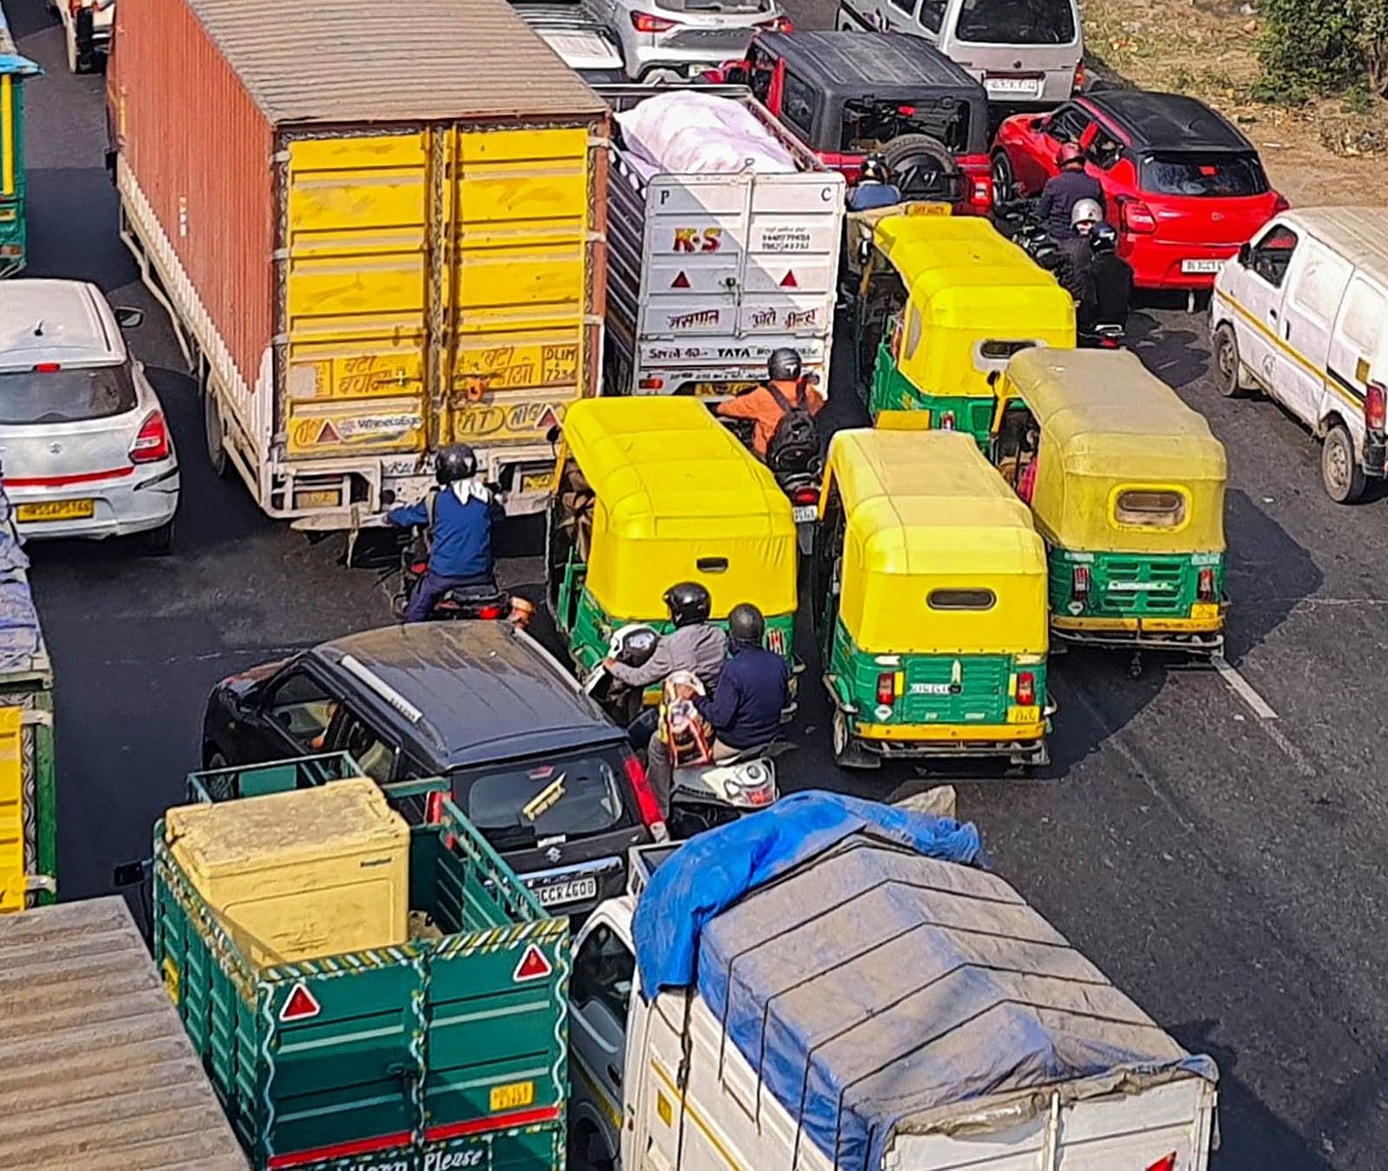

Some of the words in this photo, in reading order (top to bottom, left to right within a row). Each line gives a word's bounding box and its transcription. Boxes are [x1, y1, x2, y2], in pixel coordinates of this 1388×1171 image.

[820, 187, 831, 202] C
[717, 348, 750, 358] TATA
[423, 1149, 483, 1171] Please
